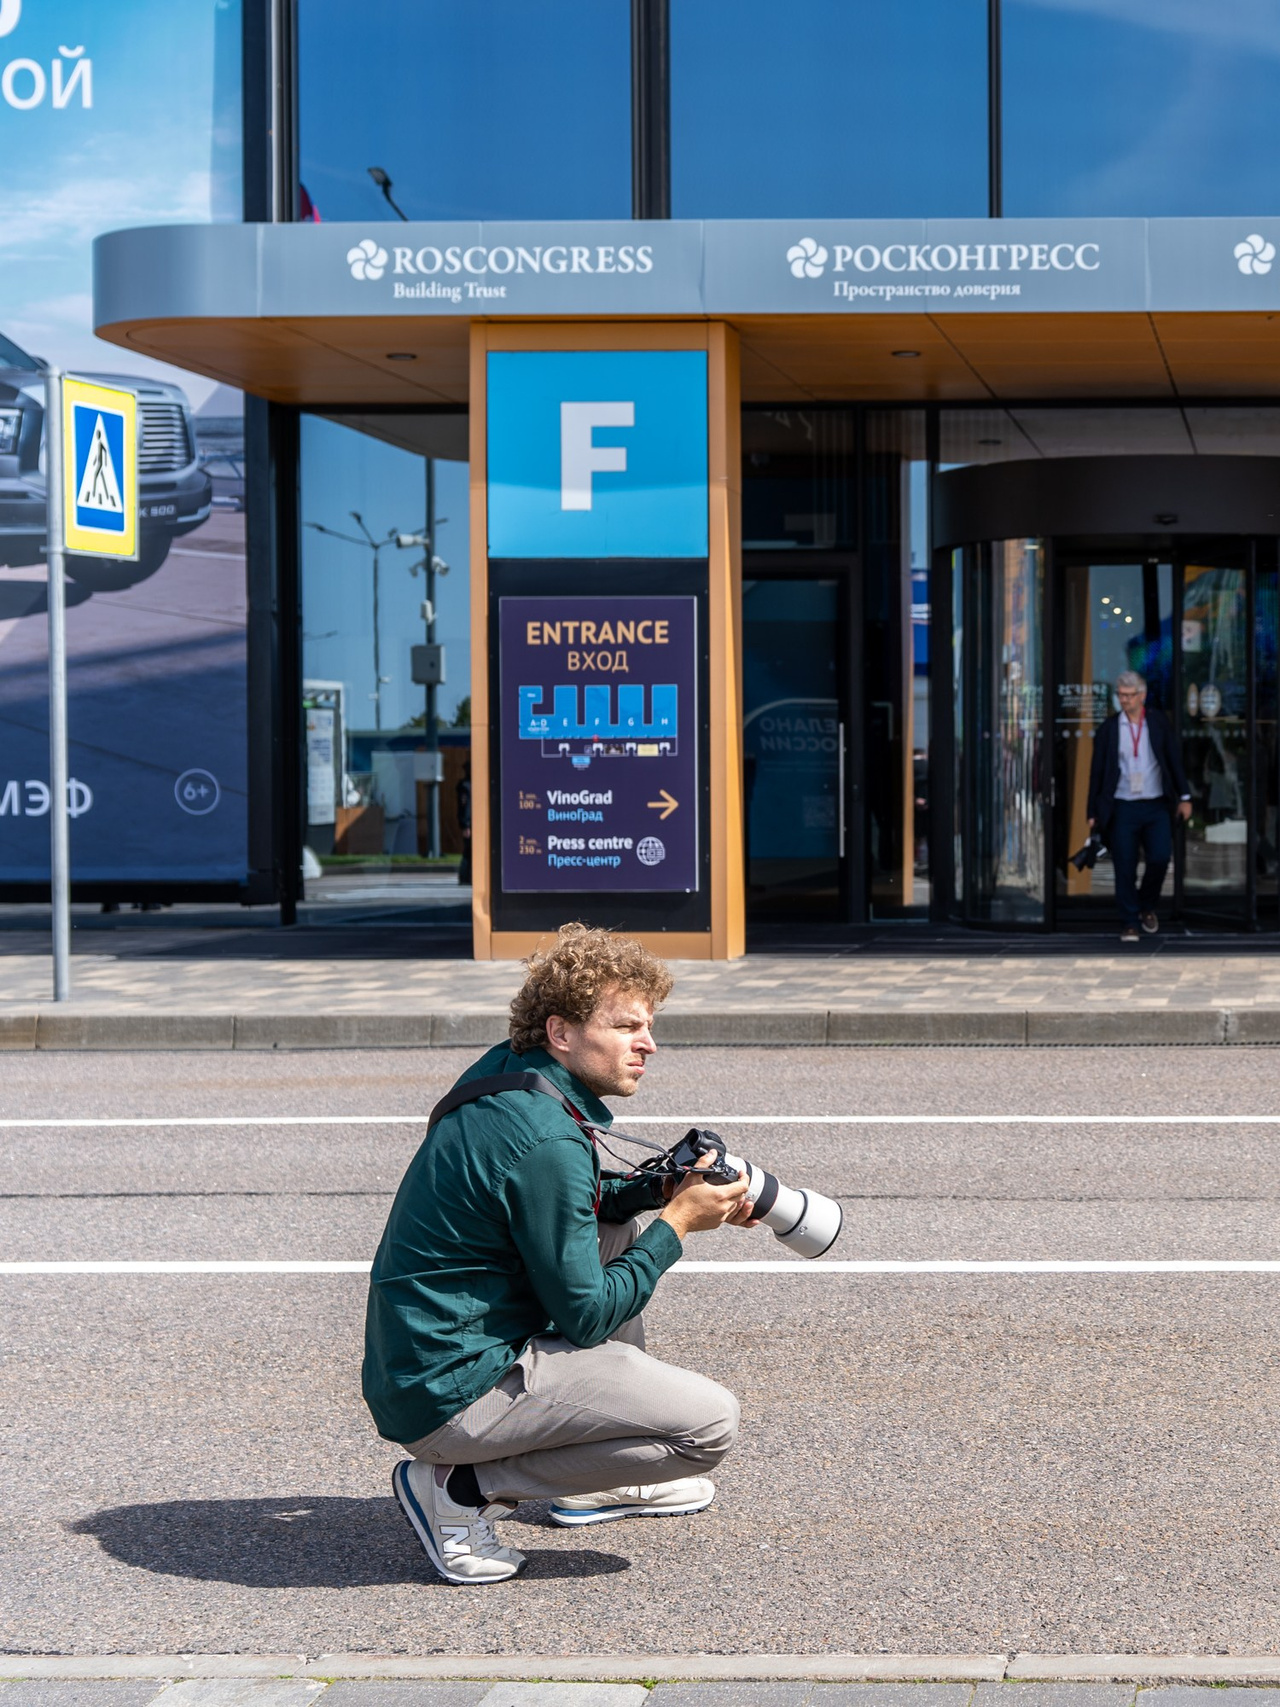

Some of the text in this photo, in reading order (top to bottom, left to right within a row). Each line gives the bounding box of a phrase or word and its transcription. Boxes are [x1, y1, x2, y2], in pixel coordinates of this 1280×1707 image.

[393, 246, 653, 274] ROSCONGRESS
[833, 243, 1100, 272] РОСКОНГРЕСС
[393, 281, 506, 303] Building Trust
[833, 281, 1021, 301] Пространство доверия
[561, 402, 634, 511] F
[526, 620, 669, 645] ENTRANCE
[567, 651, 629, 673] ВХОД
[183, 781, 209, 801] 6+
[547, 789, 613, 805] VinoGrad
[547, 808, 604, 823] ВиноГрад
[547, 835, 586, 851] Press
[587, 836, 634, 850] centre
[547, 853, 622, 869] Пресс-центр
